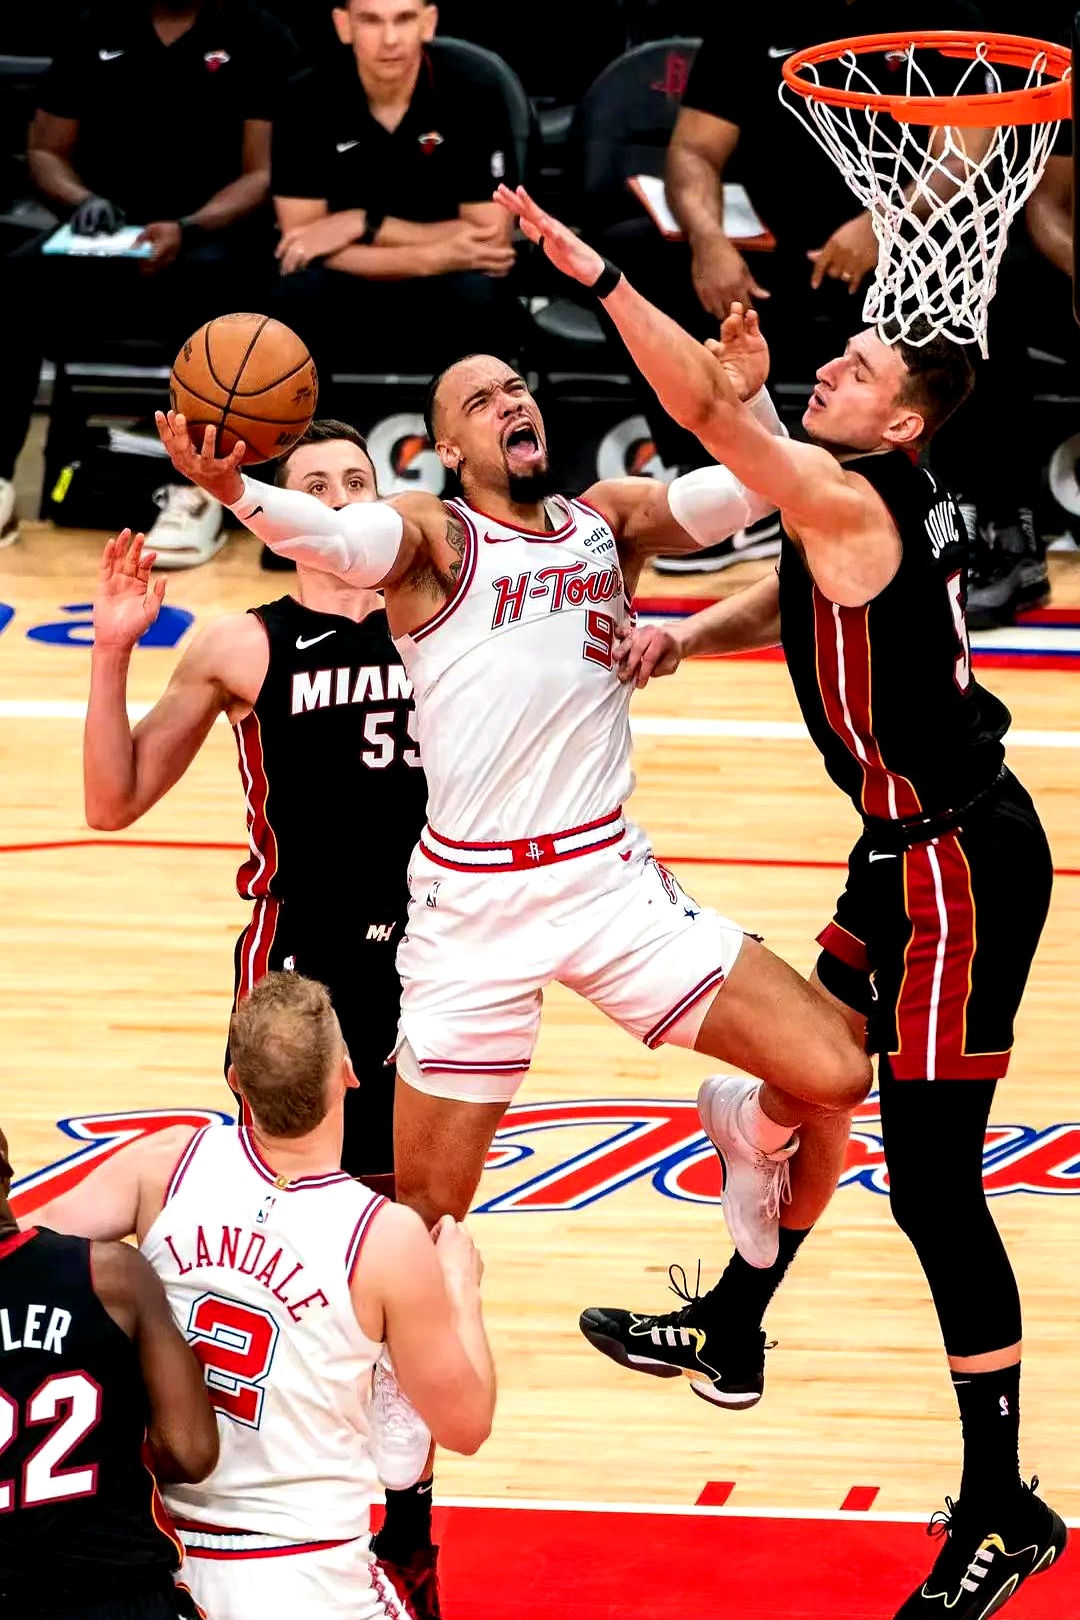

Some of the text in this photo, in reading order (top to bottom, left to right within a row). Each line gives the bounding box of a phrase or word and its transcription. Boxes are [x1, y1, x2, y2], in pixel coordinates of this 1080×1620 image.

[164, 1224, 330, 1324] LANDALE
[186, 1291, 281, 1431] 2
[0, 1368, 103, 1514] 2
